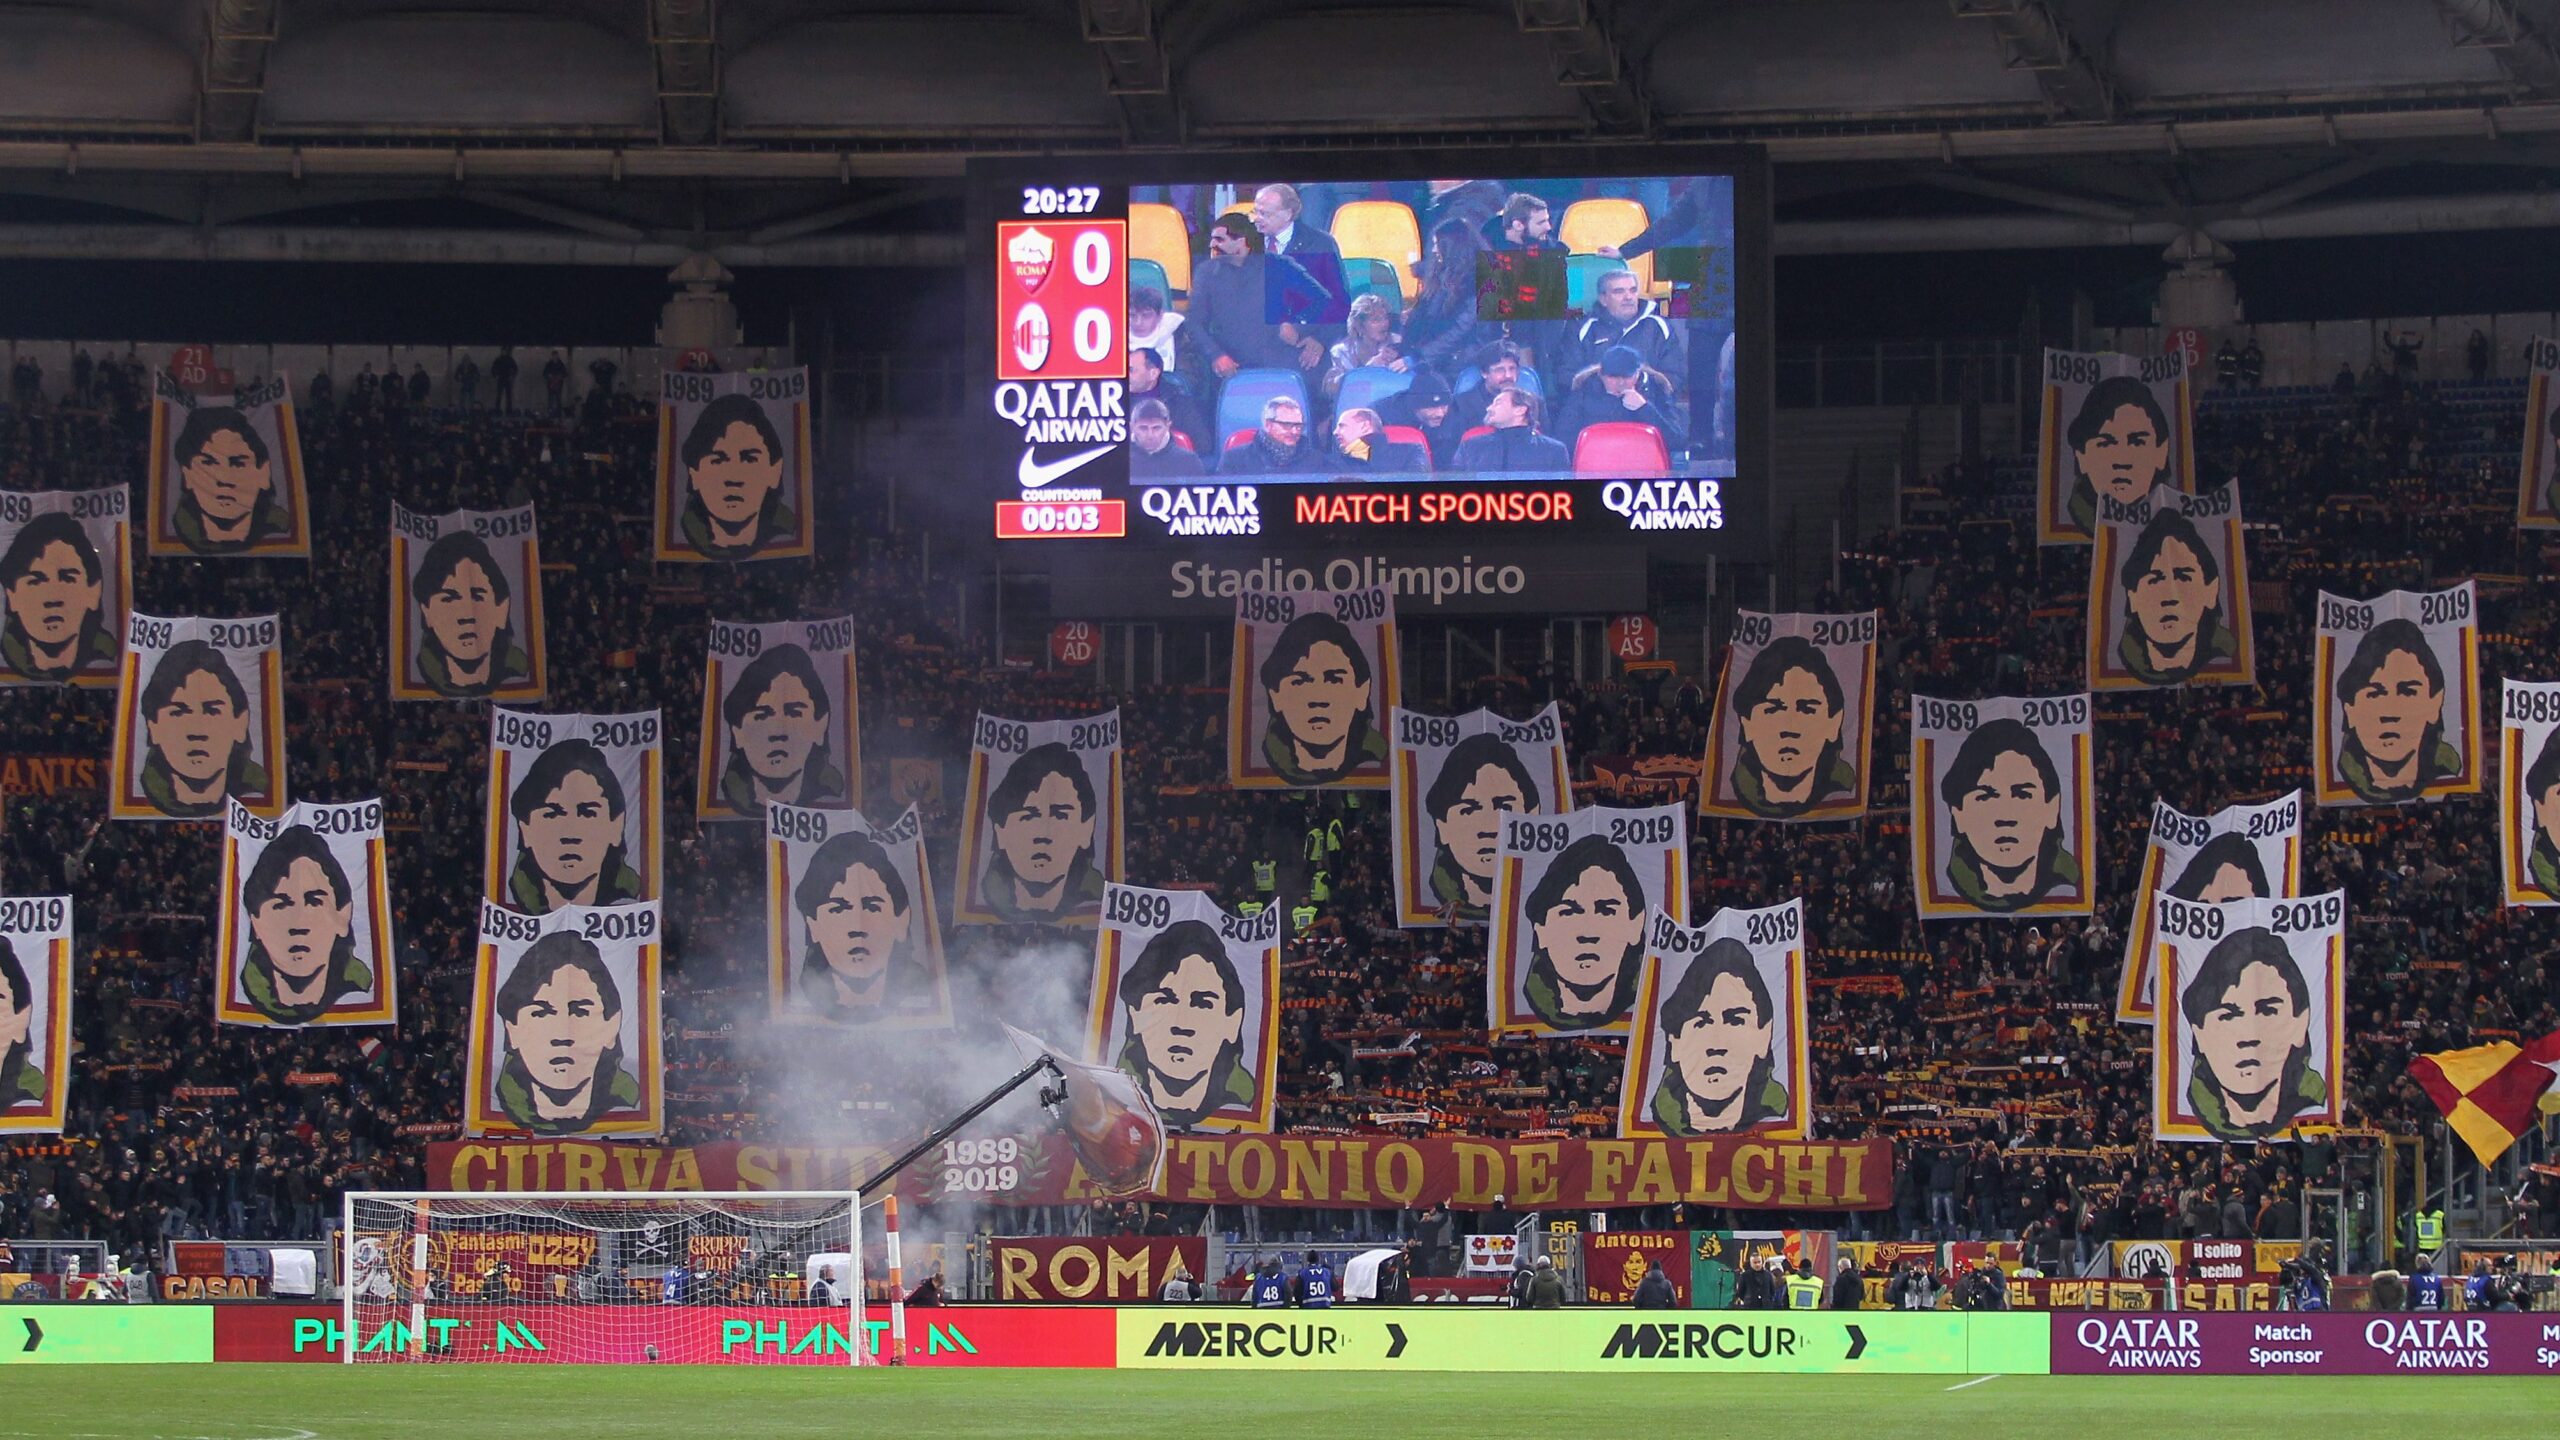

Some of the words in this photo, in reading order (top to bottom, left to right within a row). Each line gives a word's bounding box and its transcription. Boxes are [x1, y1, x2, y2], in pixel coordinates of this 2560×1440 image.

[1023, 187, 1100, 214] 20:27
[1016, 265, 1047, 276] ROMA
[1073, 231, 1111, 286] 0
[1074, 307, 1111, 363] 0
[184, 348, 202, 365] 21
[2050, 354, 2100, 385] 1989
[2140, 351, 2182, 383] 2019
[181, 367, 207, 384] AD
[663, 373, 714, 403] 1989
[750, 373, 806, 400] 2019
[994, 381, 1125, 427] QATAR
[1025, 419, 1126, 443] AIRWAYS
[73, 490, 126, 519] 2019
[1021, 489, 1102, 502] COUNTDOWN
[1141, 486, 1259, 522] QATAR
[1296, 495, 1411, 524] MATCH
[1419, 492, 1573, 523] SPONSOR
[1602, 480, 1721, 517] QATAR
[2101, 493, 2151, 525] 1989
[2180, 487, 2232, 518] 2019
[395, 507, 439, 542] 1989
[474, 510, 533, 538] 2019
[1021, 506, 1099, 532] 00:03
[1168, 516, 1261, 536] AIRWAYS
[1629, 510, 1722, 530] AIRWAYS
[1171, 558, 1314, 598] Stadio
[1325, 555, 1525, 605] Olimpico
[1240, 591, 1296, 624] 1989
[1334, 589, 1386, 622] 2019
[2320, 599, 2374, 632] 1989
[2420, 588, 2471, 626] 2019
[130, 620, 173, 649] 1989
[210, 620, 276, 648] 2019
[709, 624, 762, 657] 1989
[807, 619, 851, 651] 2019
[1066, 621, 1089, 640] 20
[1620, 616, 1642, 635] 19
[1811, 616, 1876, 646] 2019
[1063, 642, 1093, 661] AD
[1620, 637, 1645, 656] AS
[1919, 700, 1979, 732] 1989
[2023, 697, 2088, 728] 2019
[2505, 688, 2560, 723] 1989
[496, 713, 552, 750] 1989
[592, 718, 658, 748] 2019
[976, 716, 1029, 753] 1989
[1070, 718, 1119, 751] 2019
[1400, 714, 1460, 748] 1989
[1499, 714, 1556, 744] 2019
[229, 801, 279, 841] 1989
[312, 803, 383, 835] 2019
[771, 804, 828, 843] 1989
[1506, 819, 1570, 853] 1989
[1610, 814, 1675, 845] 2019
[2154, 804, 2211, 847] 1989
[2246, 800, 2297, 839] 2019
[0, 898, 66, 934] 2019
[482, 904, 541, 941] 1989
[584, 910, 656, 940] 2019
[1105, 888, 1171, 929] 1989
[1220, 906, 1279, 943] 2019
[1746, 906, 1800, 946] 2019
[2159, 899, 2225, 941] 1989
[2271, 897, 2341, 934] 2019
[944, 1137, 1018, 1166] 1989
[451, 1143, 704, 1204] CURVA
[736, 1143, 898, 1206] SUD
[944, 1165, 1019, 1192] 2019
[1452, 1142, 1559, 1205] DE
[1585, 1140, 1869, 1206] FALCHI
[450, 1233, 525, 1251] Fantasmi
[528, 1235, 596, 1265] OZZY
[689, 1236, 749, 1256] GRUPPO
[1595, 1233, 1675, 1249] Antonio
[2194, 1243, 2203, 1258] il
[2204, 1243, 2242, 1258] solito
[454, 1273, 522, 1294] Pasto
[1001, 1244, 1189, 1300] ROMA
[1309, 1268, 1323, 1276] TV
[2200, 1263, 2243, 1279] ecchio
[1169, 1288, 1183, 1299] 223
[1262, 1285, 1279, 1301] 48
[1309, 1281, 1325, 1297] 50
[1589, 1286, 1612, 1303] De
[2007, 1281, 2036, 1306] EL
[2050, 1281, 2104, 1307] NOME
[2421, 1290, 2437, 1305] 22
[2077, 1318, 2200, 1354] QATAR
[2255, 1323, 2312, 1341] Match
[2365, 1319, 2488, 1355] QATAR
[2109, 1350, 2201, 1368] AIRWAYS
[2250, 1347, 2323, 1368] Sponsor
[2396, 1350, 2489, 1368] AIRWAYS
